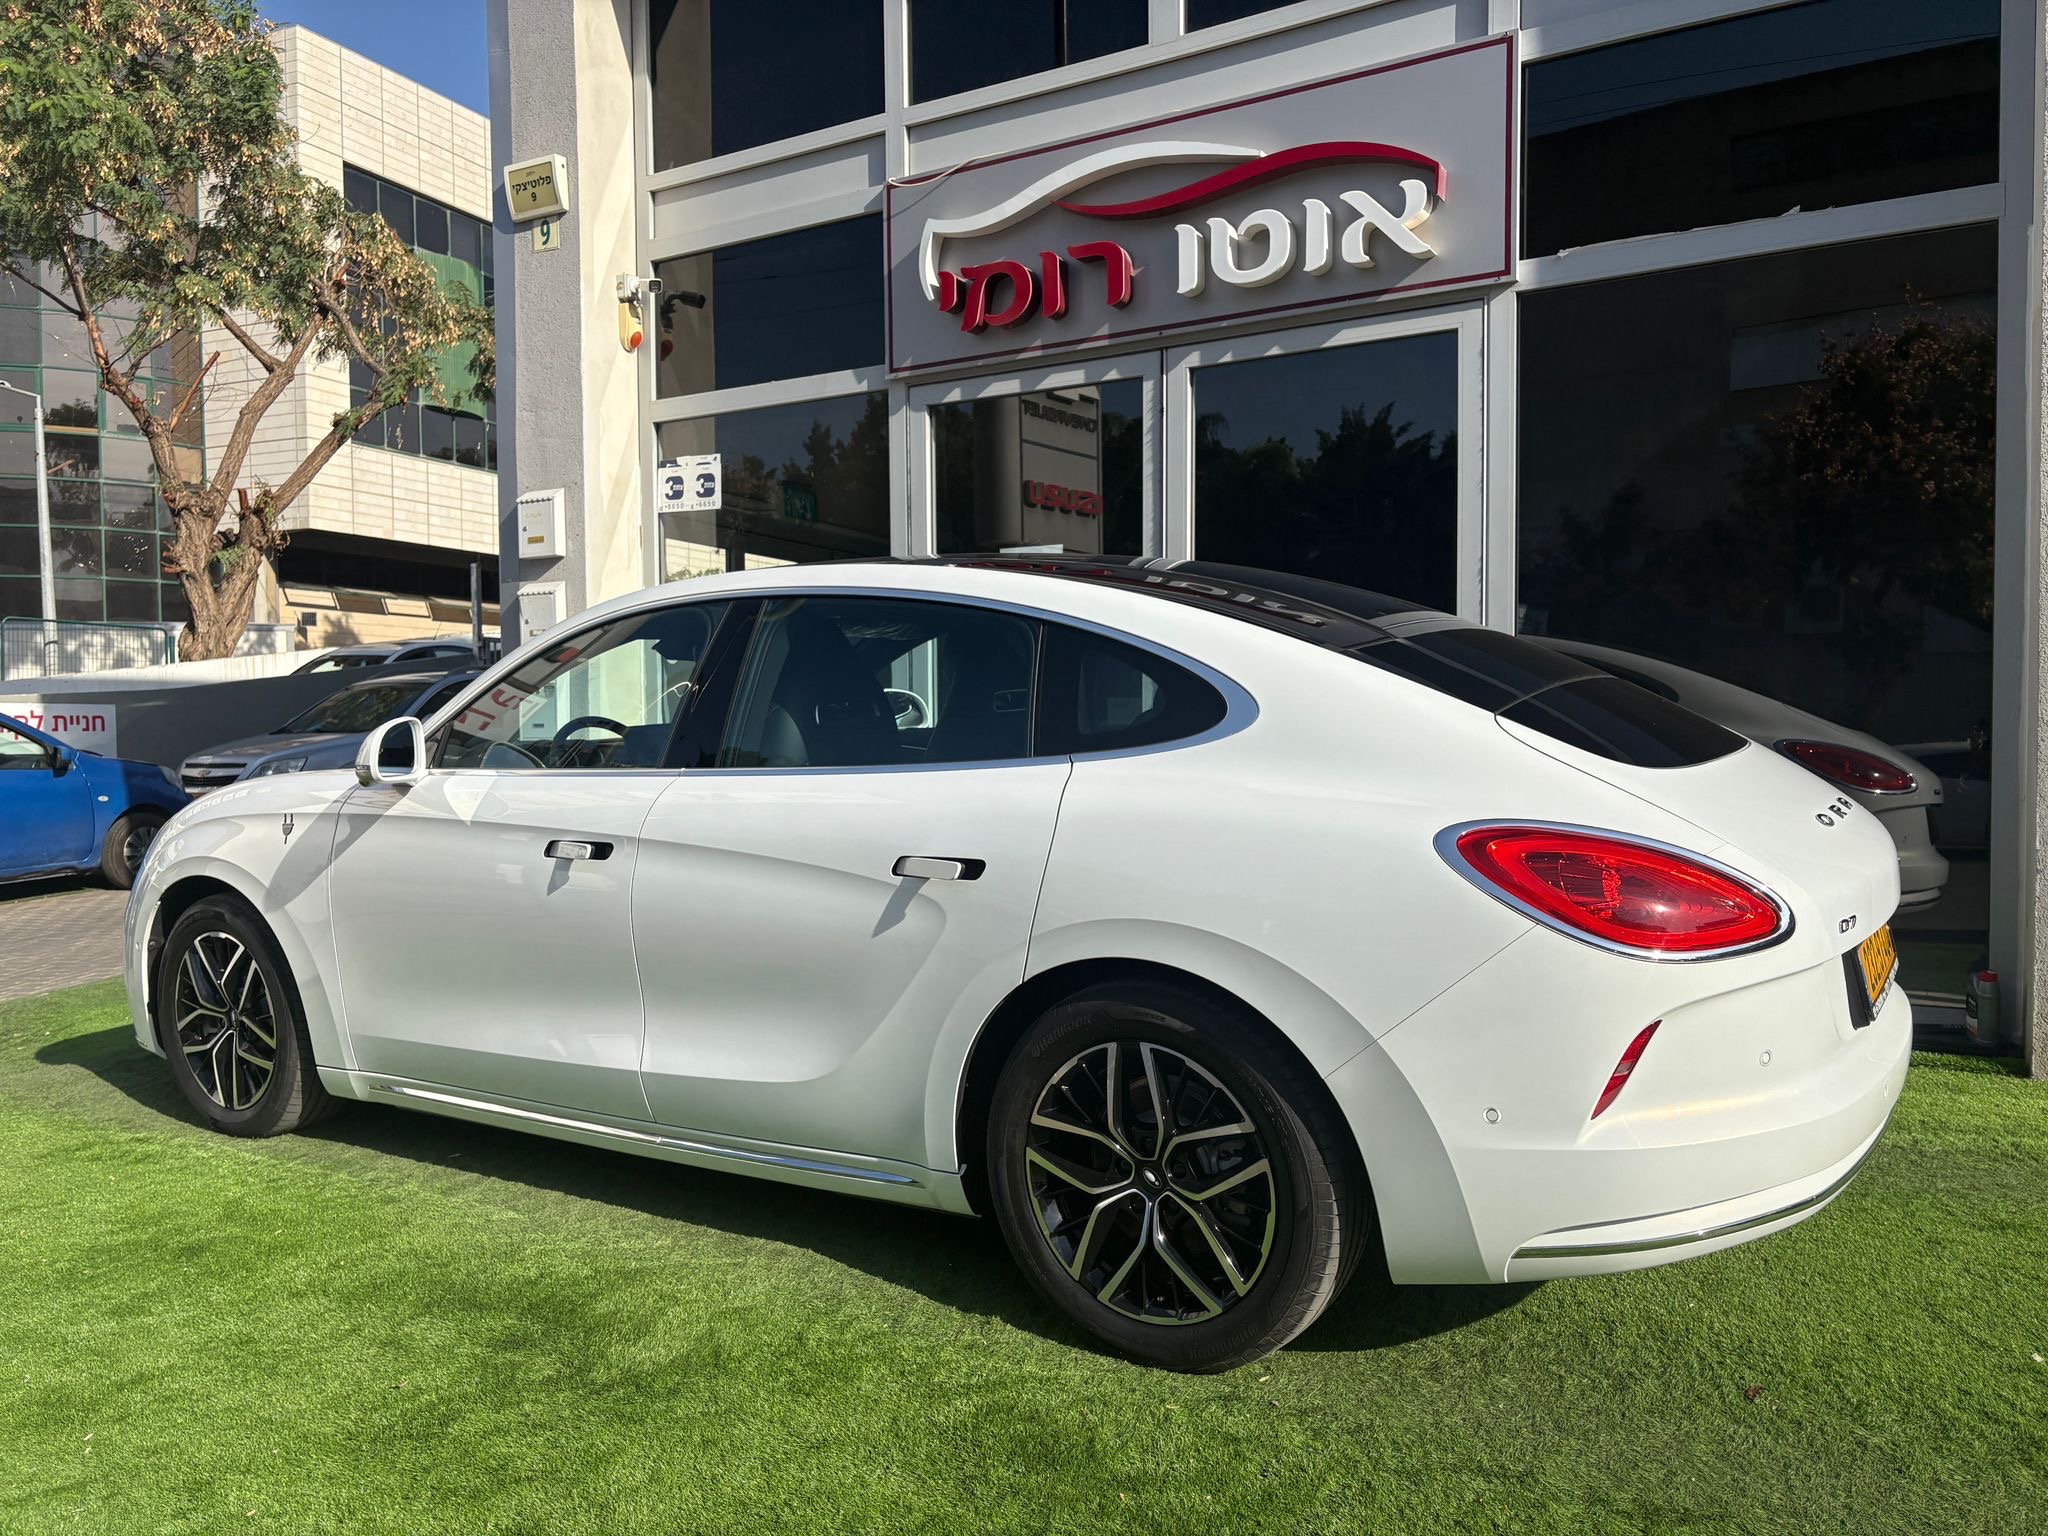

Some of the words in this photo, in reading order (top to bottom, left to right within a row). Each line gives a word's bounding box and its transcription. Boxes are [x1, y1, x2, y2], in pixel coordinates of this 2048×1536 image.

[511, 174, 552, 197] פלוטיצקי
[530, 191, 538, 202] 9
[540, 219, 551, 246] 9
[1174, 178, 1439, 300] אוטו
[937, 240, 1134, 336] רומי
[52, 714, 106, 732] חניית
